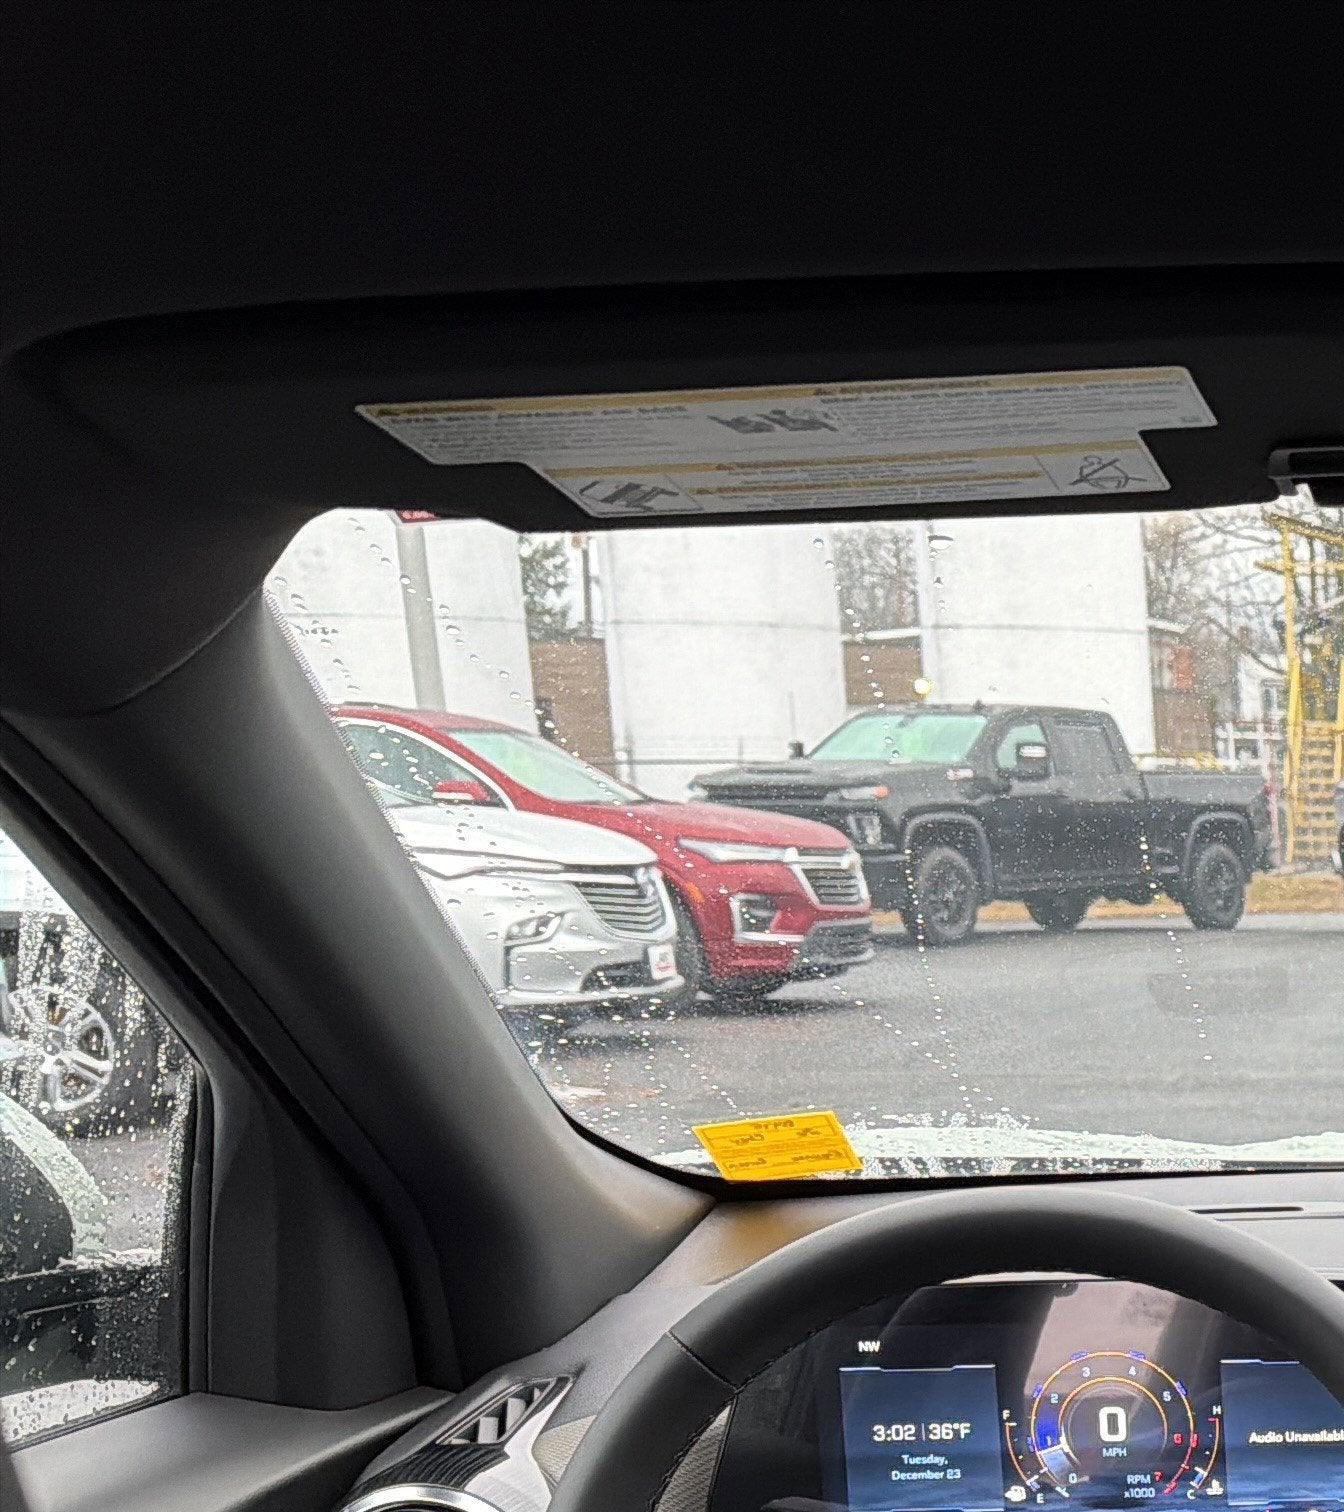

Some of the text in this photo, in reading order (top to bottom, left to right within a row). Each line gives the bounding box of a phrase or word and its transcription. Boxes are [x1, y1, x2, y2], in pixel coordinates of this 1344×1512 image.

[857, 1341, 881, 1352] NW
[1082, 1367, 1091, 1377] 3
[1128, 1366, 1137, 1376] 4
[1050, 1393, 1059, 1404] 2
[1163, 1391, 1171, 1401] 5
[1002, 1409, 1011, 1420] F
[1212, 1405, 1222, 1415] H
[1098, 1406, 1127, 1442] 0
[872, 1423, 971, 1442] 3:02 36°F
[1249, 1432, 1284, 1444] Audio
[1103, 1448, 1127, 1458] MPH
[901, 1454, 949, 1466] Tuesday,
[891, 1470, 945, 1481] December
[1068, 1473, 1077, 1483] 0
[1127, 1474, 1151, 1485] RPM
[1037, 1493, 1045, 1504] E
[1187, 1489, 1196, 1500] C
